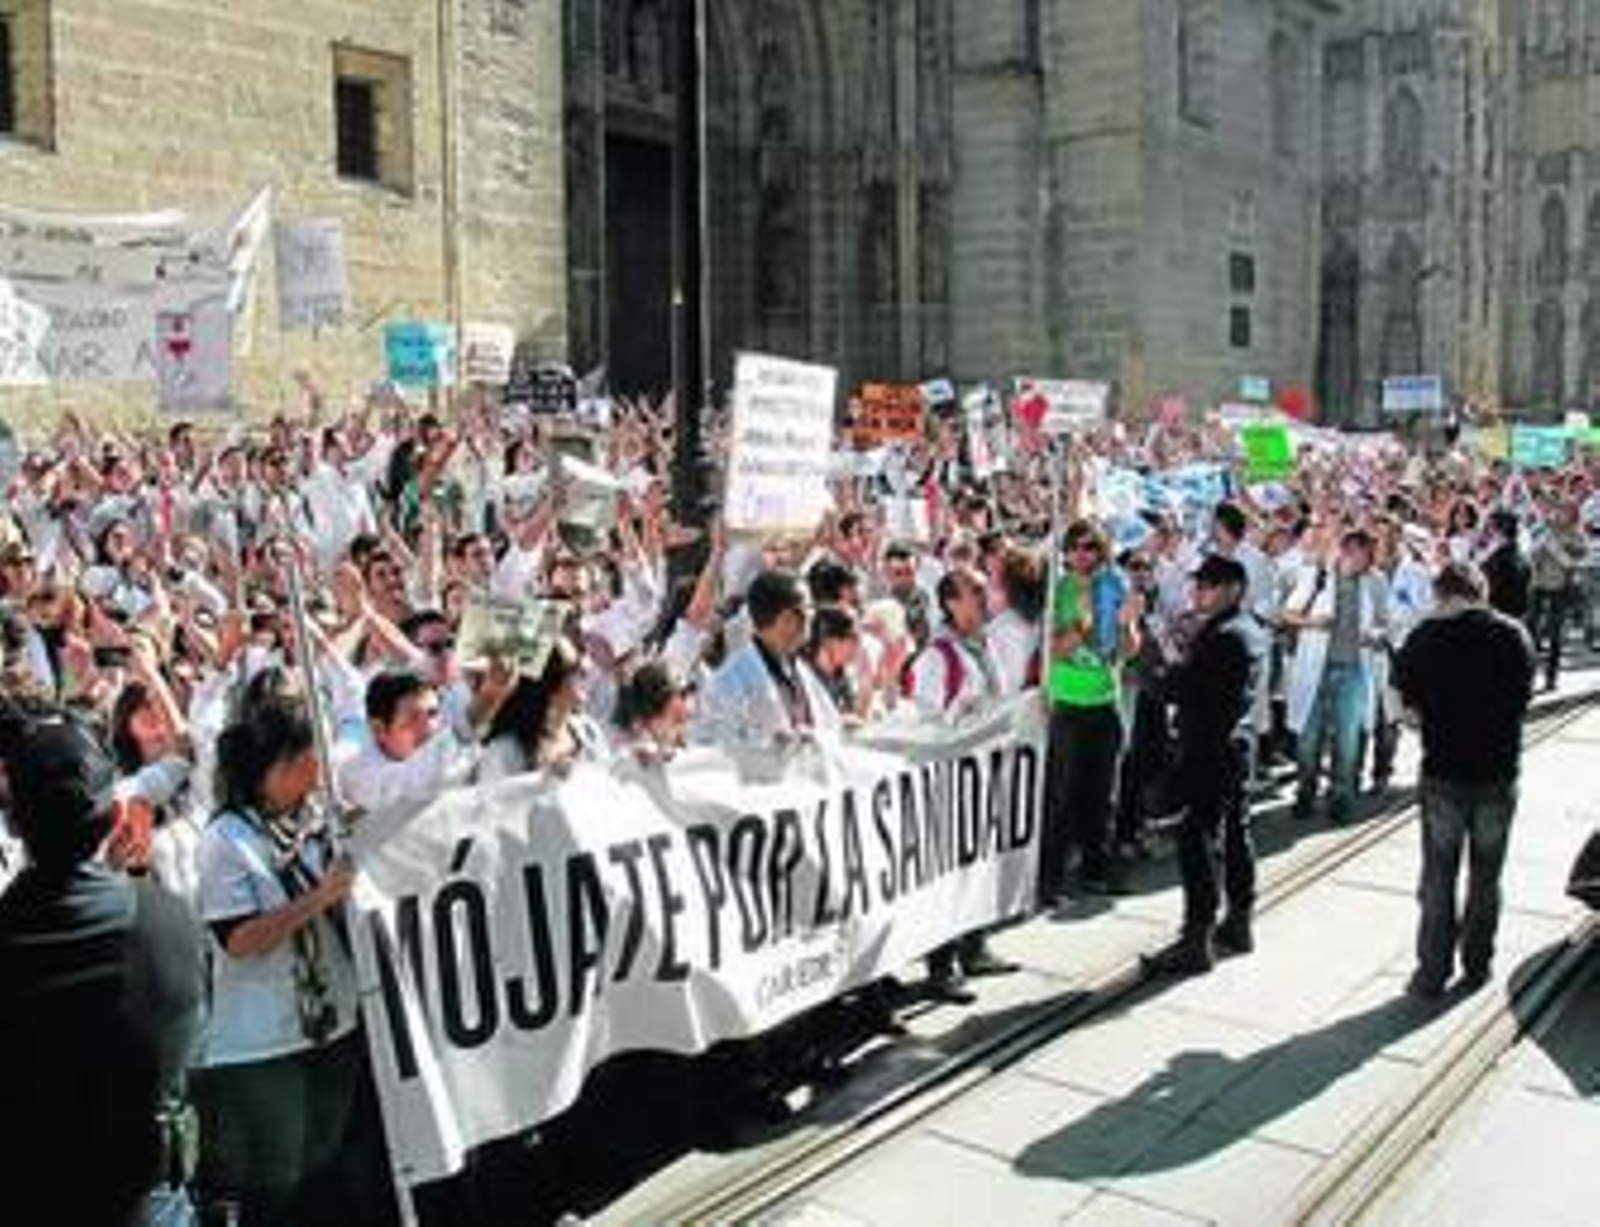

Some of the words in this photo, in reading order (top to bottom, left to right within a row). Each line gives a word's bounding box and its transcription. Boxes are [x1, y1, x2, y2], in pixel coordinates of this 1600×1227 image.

[369, 833, 690, 1079] MÓJATE
[686, 809, 801, 972] POR
[815, 790, 869, 927] LA
[872, 744, 1036, 904] SANIDAD
